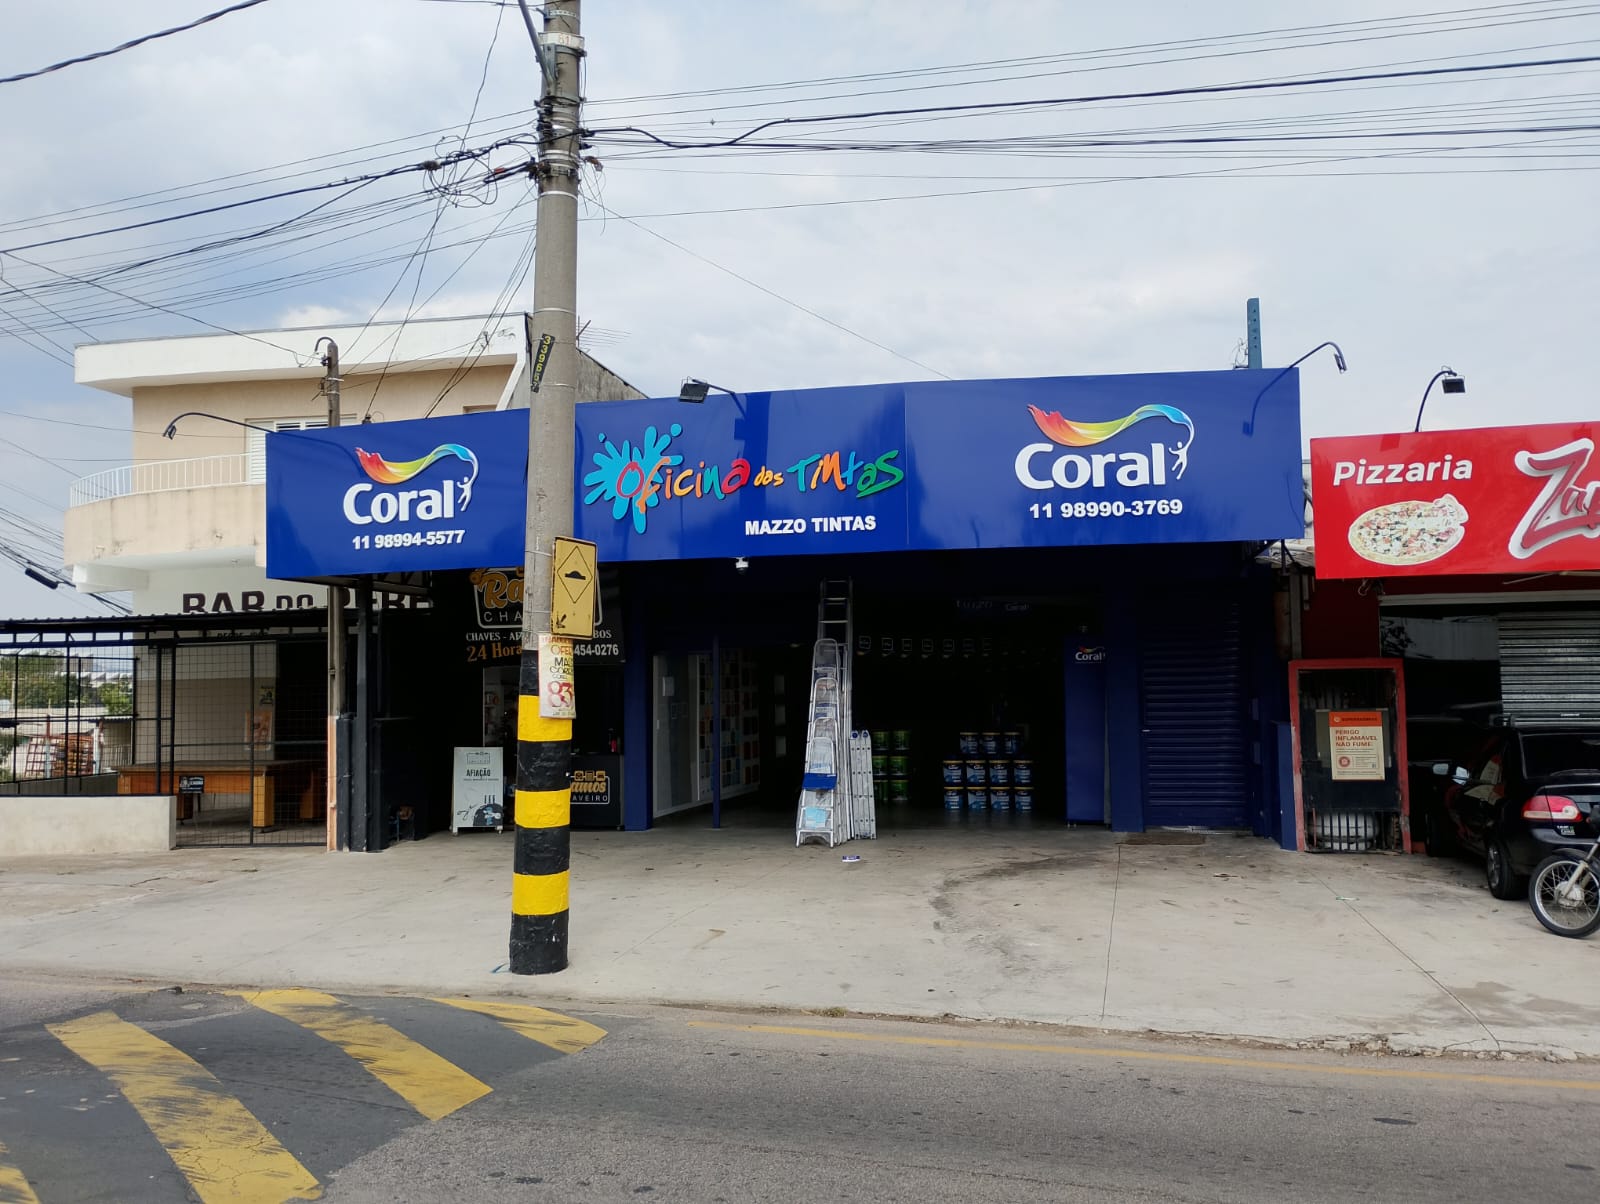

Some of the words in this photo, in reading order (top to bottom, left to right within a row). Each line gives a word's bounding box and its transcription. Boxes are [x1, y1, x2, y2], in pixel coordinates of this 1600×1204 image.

[1015, 443, 1166, 490] Coral
[1333, 454, 1473, 486] Pizzaria
[616, 456, 751, 514] Oficina
[343, 480, 455, 525] Coral
[1029, 503, 1053, 519] 11
[1060, 499, 1183, 518] 98990-3769
[745, 518, 806, 536] MAZZO
[812, 515, 876, 533] TINTAS
[352, 535, 370, 550] 11
[374, 529, 465, 549] 98994-5577
[483, 611, 523, 622] CHA
[466, 632, 501, 641] CHAVES
[593, 630, 612, 639] BOS
[466, 645, 487, 662] 24
[492, 642, 523, 658] Hora
[574, 644, 619, 656] 454-0276
[1075, 652, 1102, 661] Coral
[466, 768, 491, 778] AFIAÇÃO
[571, 781, 607, 793] amos
